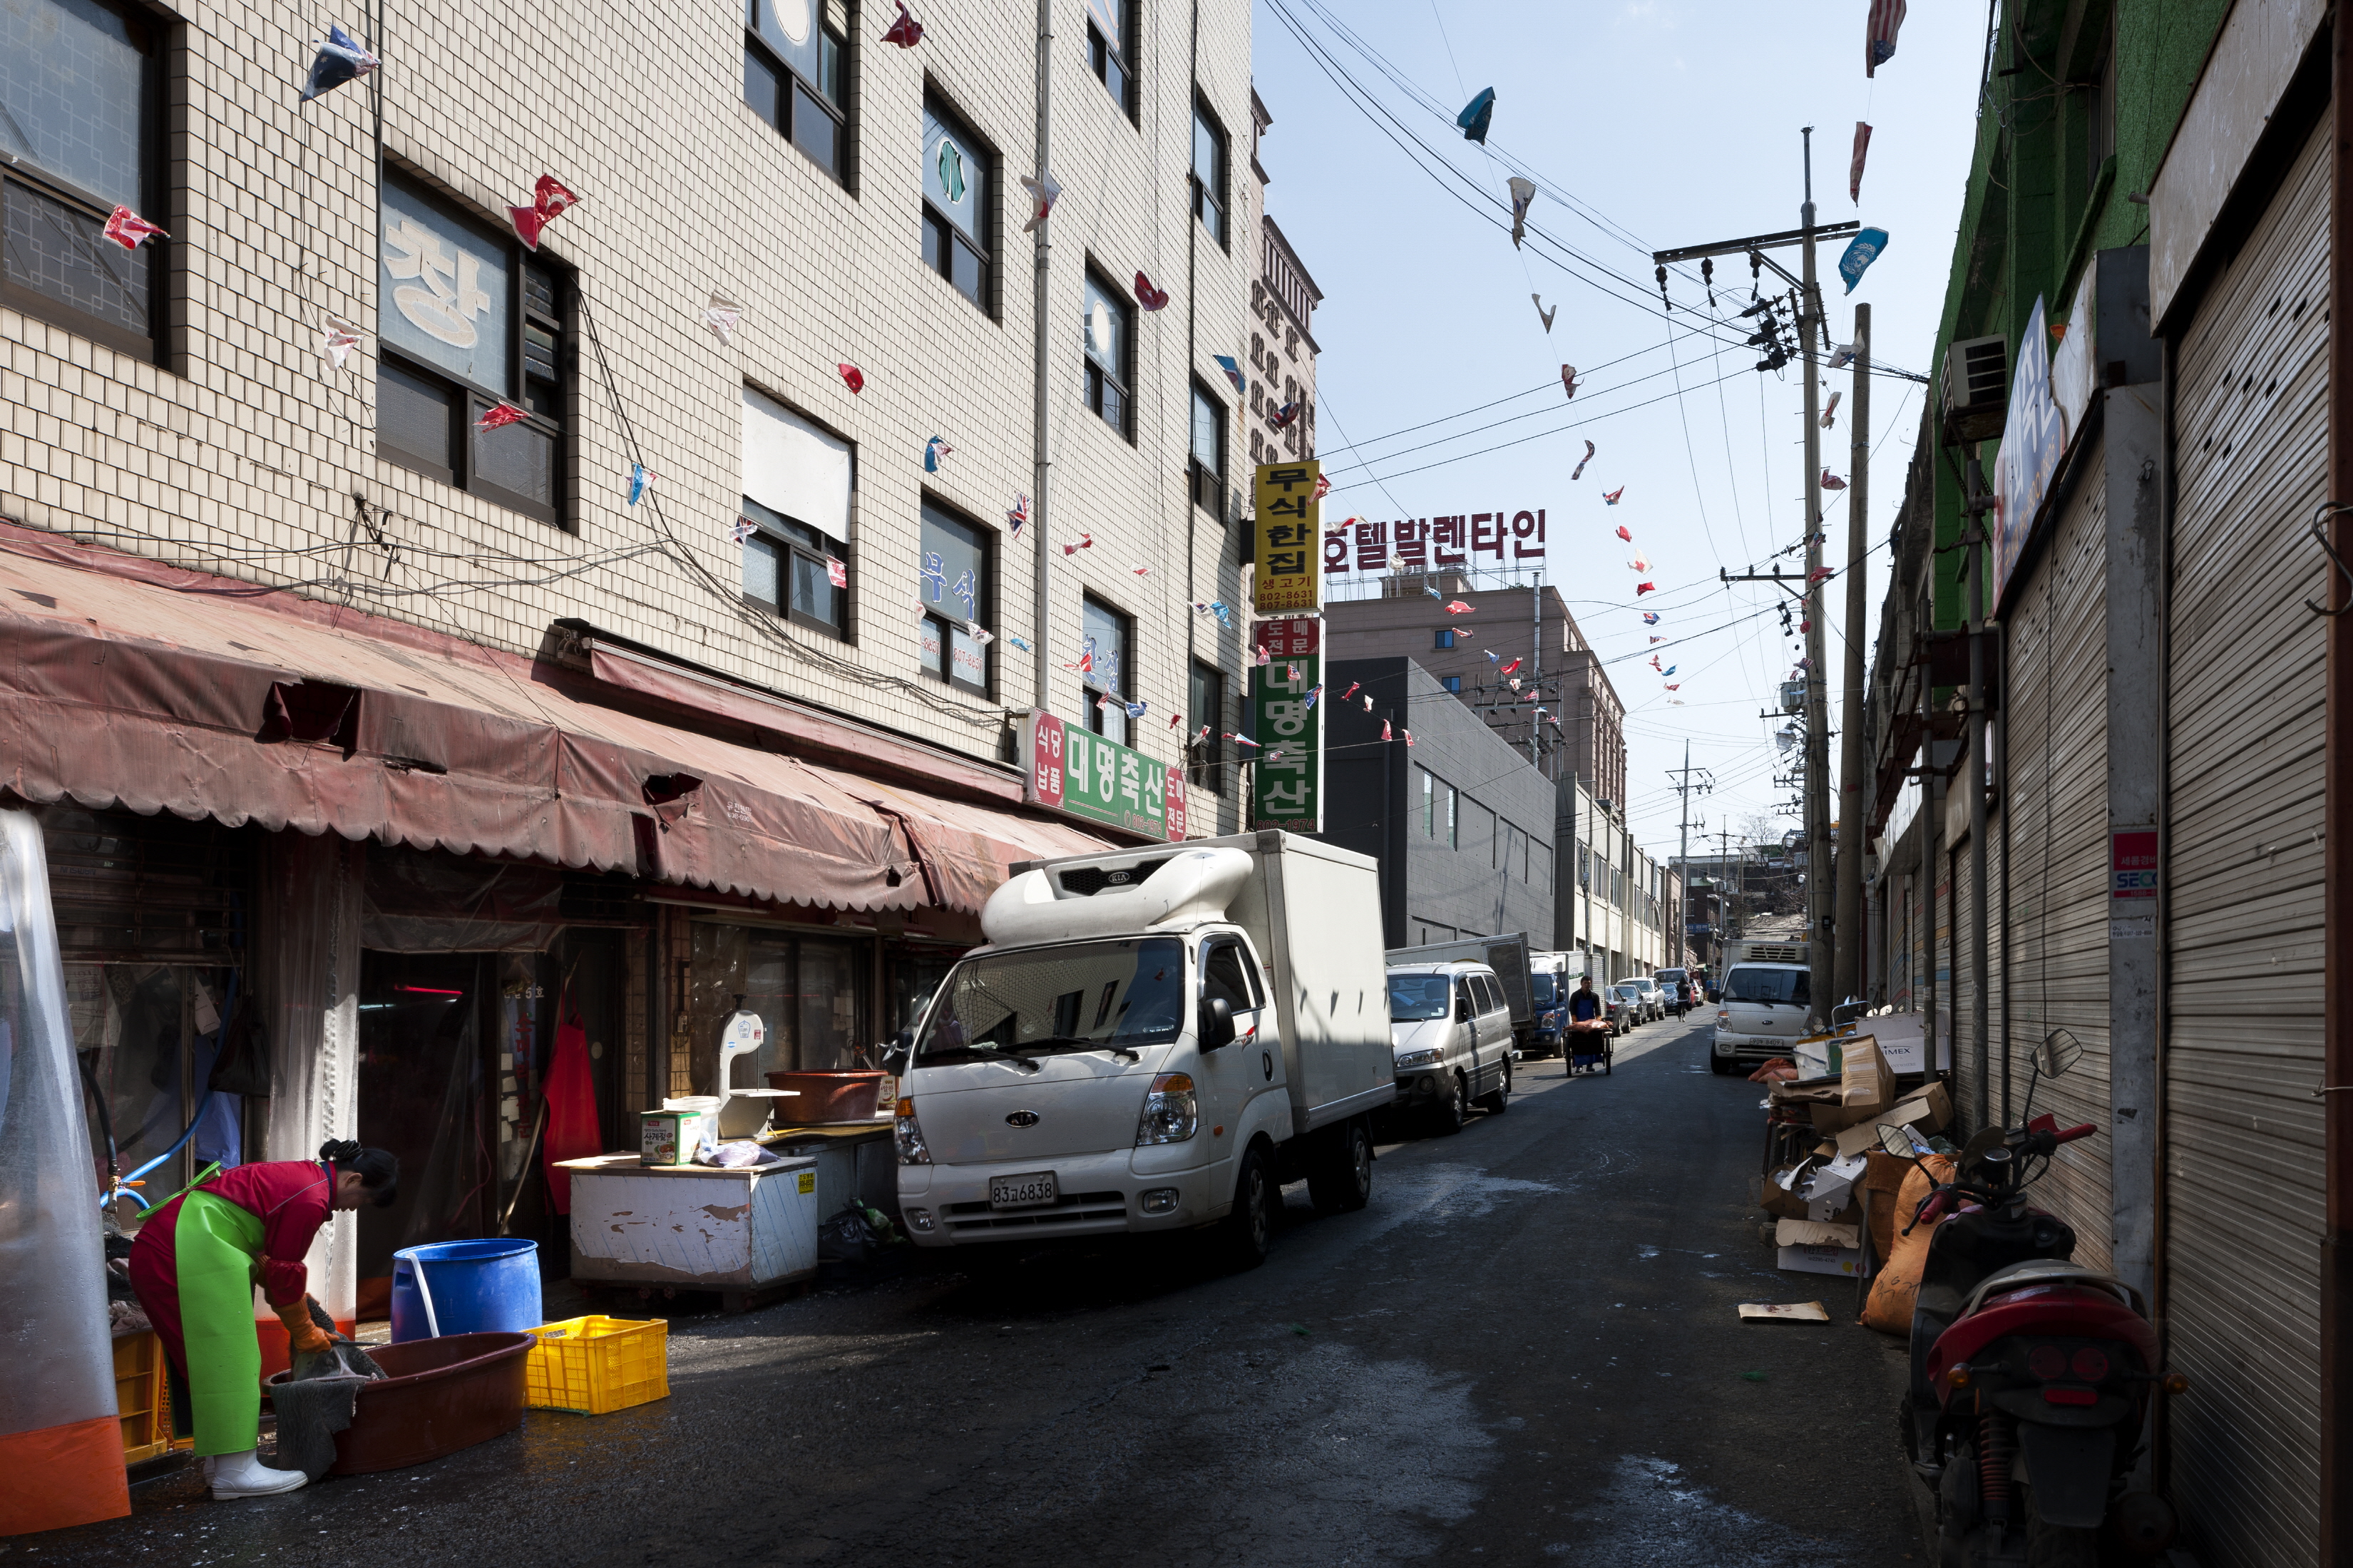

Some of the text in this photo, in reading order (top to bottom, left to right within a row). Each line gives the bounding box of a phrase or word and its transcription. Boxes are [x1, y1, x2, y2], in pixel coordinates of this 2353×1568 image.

[1266, 468, 1312, 575] 무식한집
[1262, 576, 1311, 590] 생고기
[1259, 590, 1313, 601] 802-8631
[1259, 599, 1313, 610] 807-8631
[1268, 620, 1308, 636] 도매
[920, 637, 940, 656] -8631
[1268, 638, 1308, 655] 전문
[953, 647, 983, 672] 807-8631
[1038, 724, 1062, 759] 식당
[1263, 660, 1311, 814] 대명축산
[1037, 762, 1060, 795] 납품
[1068, 730, 1164, 818] 대명축산
[1167, 775, 1184, 804] 도매
[1132, 814, 1162, 836] 802-1974
[1167, 806, 1184, 834] 전문
[1256, 819, 1316, 831] 802-1974
[1111, 873, 1127, 882] KIA
[1010, 1113, 1035, 1125] KIA
[644, 1132, 666, 1141] 사계절
[993, 1183, 1052, 1203] 83고6838
